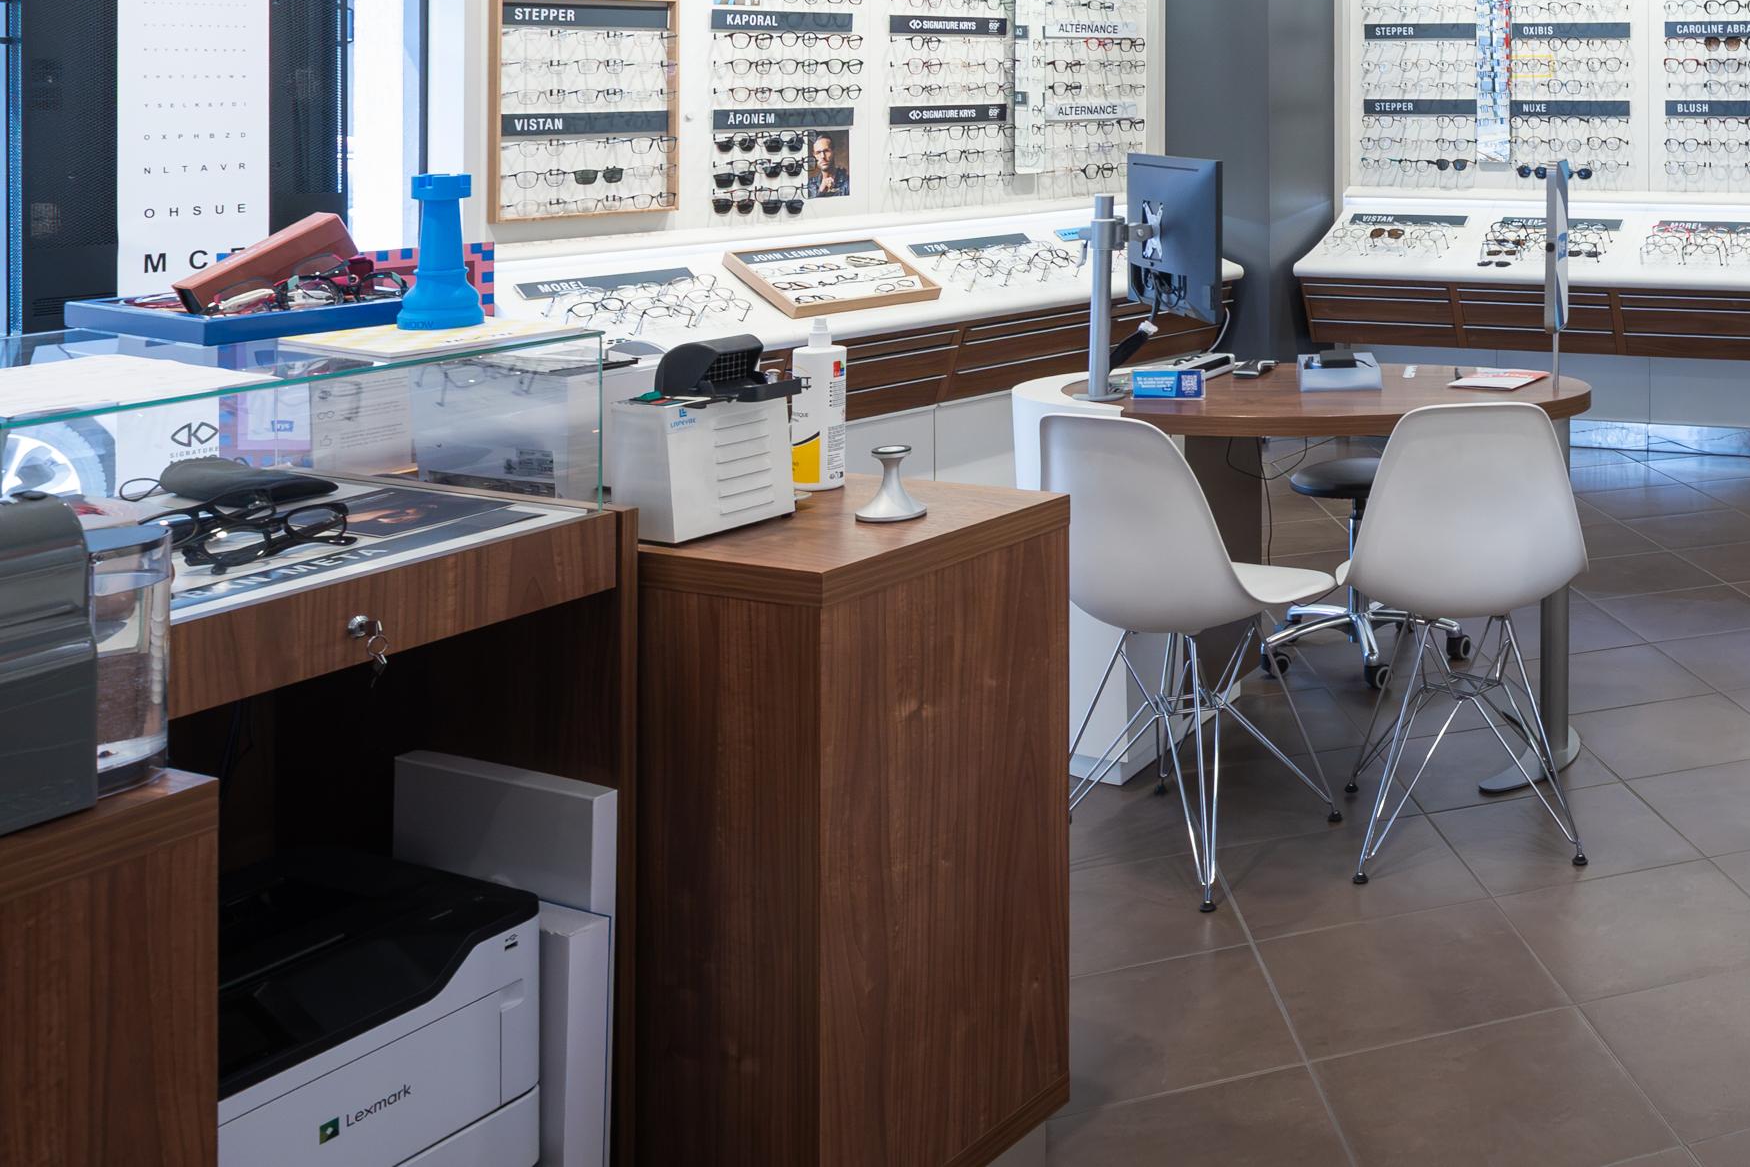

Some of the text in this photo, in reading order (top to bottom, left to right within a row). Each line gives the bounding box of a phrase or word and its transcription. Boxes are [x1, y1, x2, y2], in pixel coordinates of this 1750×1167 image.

[514, 7, 576, 22] STEPPER
[726, 13, 778, 27] KAPORAL
[922, 20, 959, 31] SIGNATURE
[959, 21, 977, 31] KRYS
[1058, 22, 1119, 34] ALTERNANCE
[1375, 26, 1414, 36] STEPPER
[1522, 25, 1554, 35] OXIBIS
[1676, 24, 1724, 34] CAROLINE
[1058, 104, 1118, 116] ALTERNANCE
[1374, 102, 1414, 112] STEPPER
[1522, 103, 1547, 113] NUXE
[1677, 103, 1709, 113] BLUSH
[727, 112, 775, 125] ÄPONEM
[922, 109, 959, 120] SIGNATURE
[959, 108, 976, 118] KRYS
[514, 117, 563, 131] VISTAN
[1362, 214, 1395, 223] VISTAN
[752, 247, 831, 263] JOHN LENNON
[144, 250, 208, 274] M C
[536, 280, 590, 294] MOREL
[281, 547, 390, 576] META
[345, 1083, 412, 1128] Lexmark
